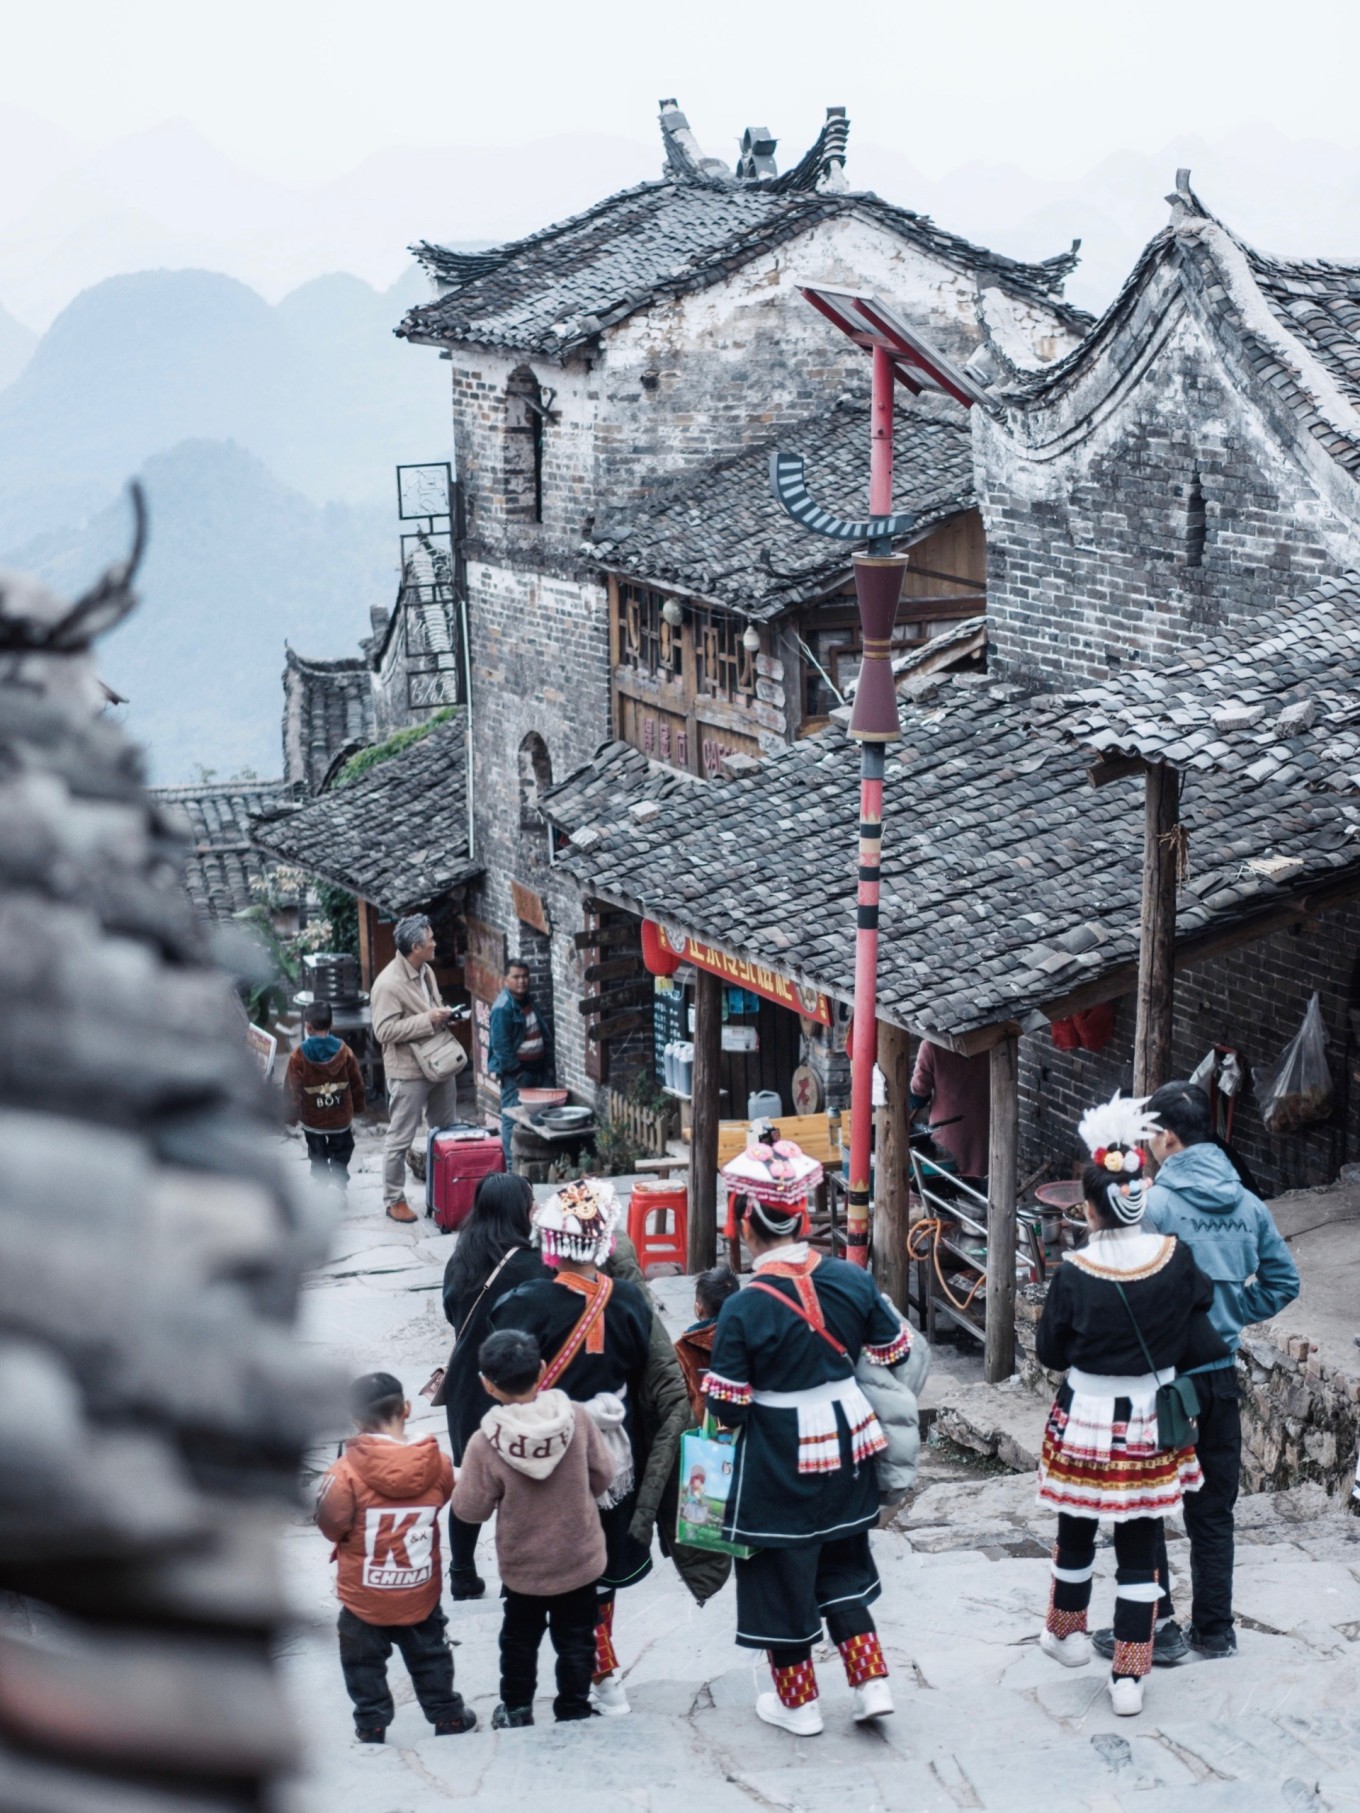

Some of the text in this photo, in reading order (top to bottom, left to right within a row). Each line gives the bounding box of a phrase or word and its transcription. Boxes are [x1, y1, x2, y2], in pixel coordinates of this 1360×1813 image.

[316, 1095, 341, 1108] BOY
[369, 1512, 422, 1568] K
[369, 1567, 428, 1585] CHINA
